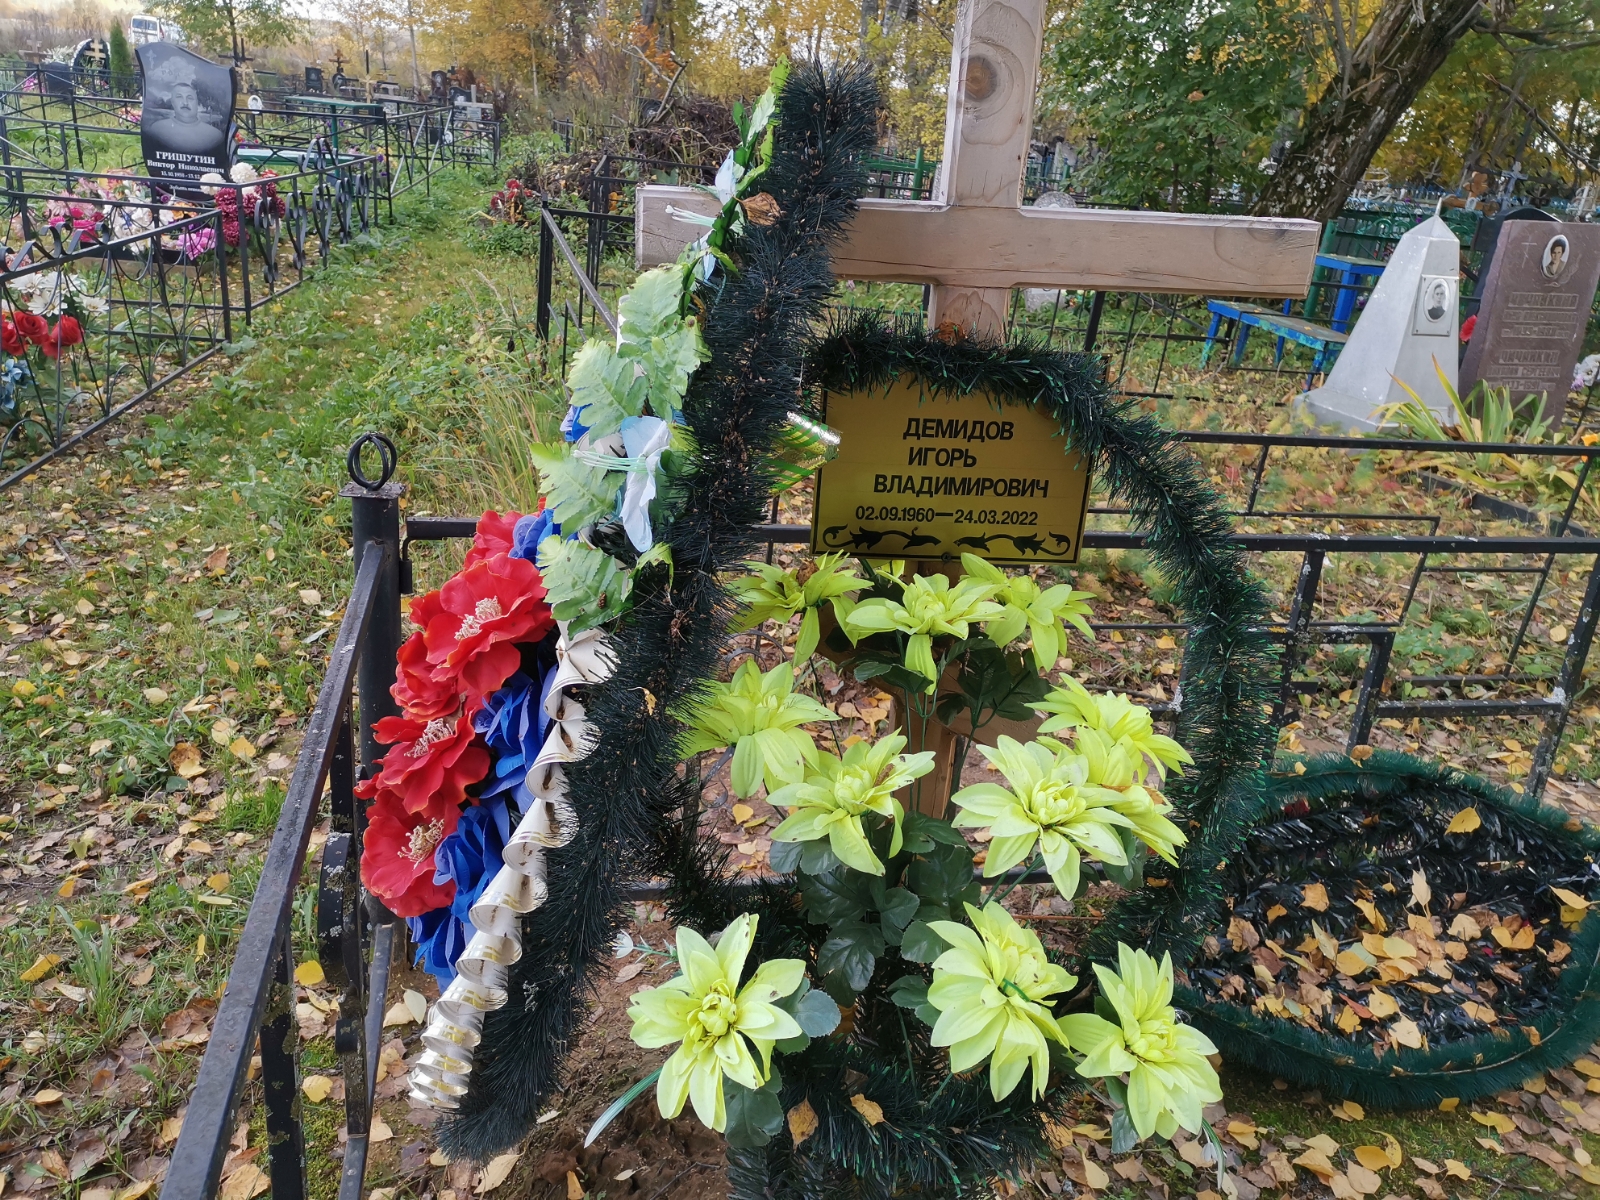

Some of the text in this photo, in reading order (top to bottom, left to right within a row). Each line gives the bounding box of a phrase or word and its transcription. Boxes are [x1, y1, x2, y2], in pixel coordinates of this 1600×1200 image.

[147, 159, 224, 174] Виктор Николаевич
[156, 151, 215, 164] ГРИШУТИН
[903, 418, 1014, 442] ДЕМИДОВ
[908, 447, 977, 468] ИГОРЬ
[873, 474, 1049, 498] ВЛАДИМИРОВИЧ
